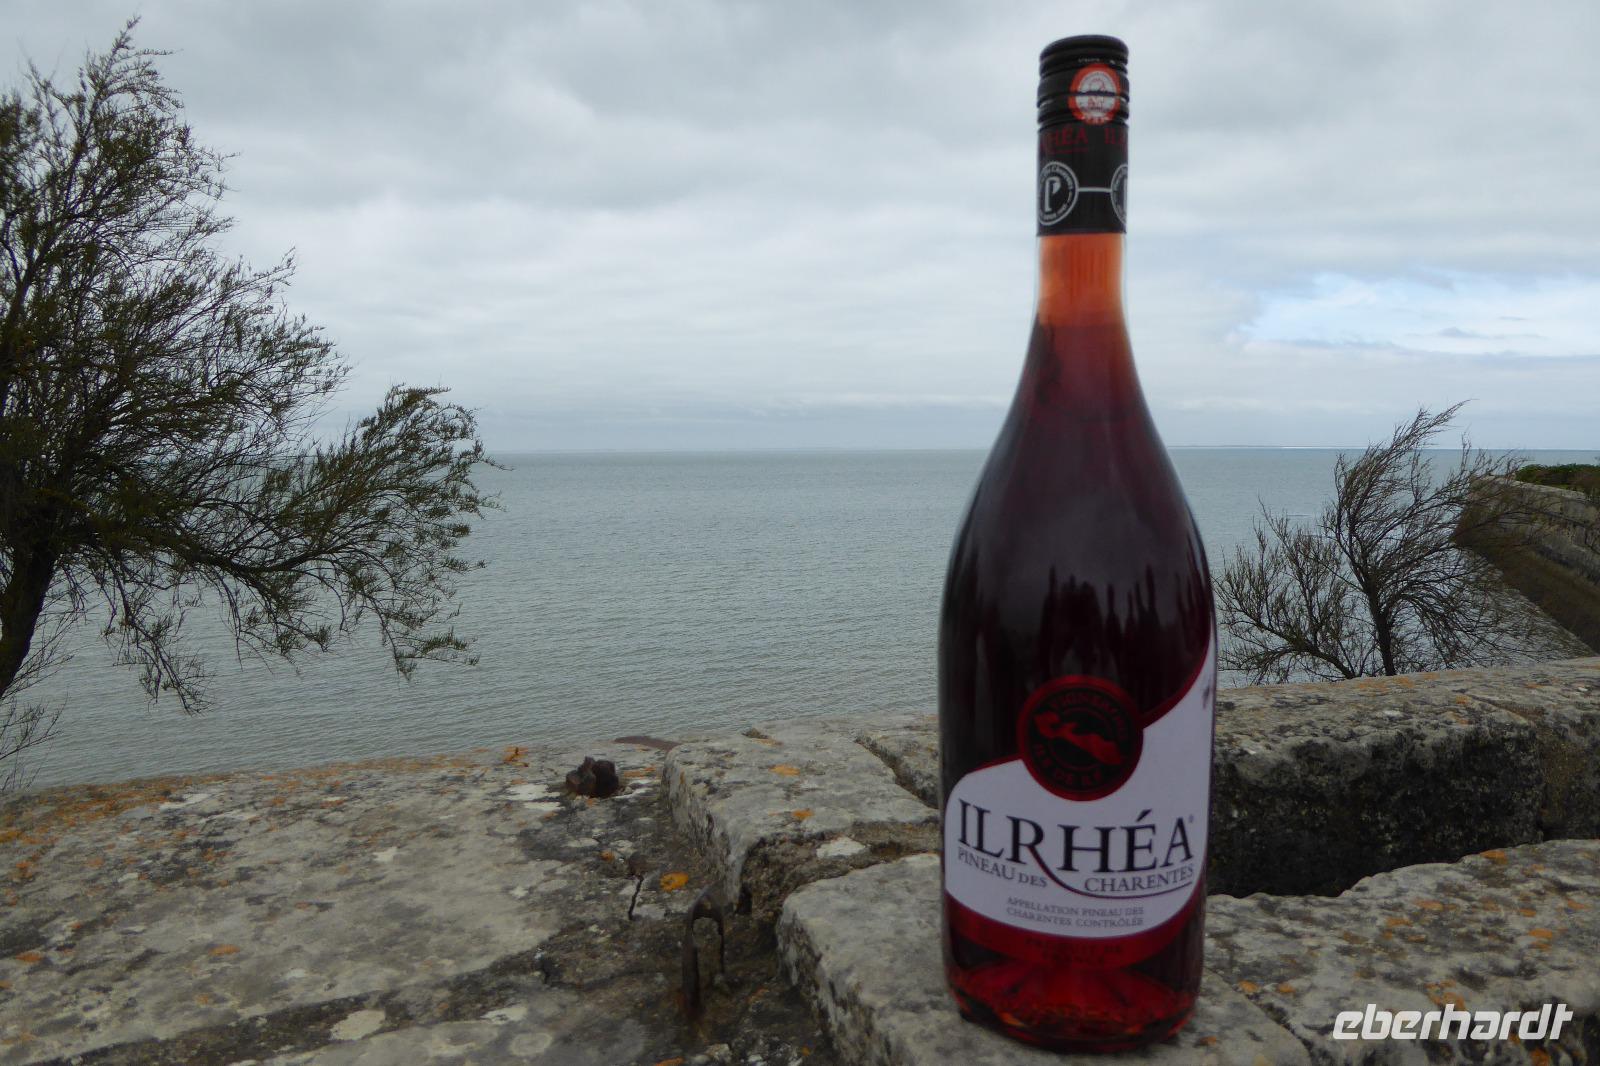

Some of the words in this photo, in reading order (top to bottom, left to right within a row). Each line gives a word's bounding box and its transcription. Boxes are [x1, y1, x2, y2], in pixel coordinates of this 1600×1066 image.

[957, 846, 1014, 880] PINEAU
[1017, 873, 1048, 889] DES
[1084, 864, 1195, 894] CHARENTES
[1006, 906, 1072, 927] CHARENTES
[1007, 896, 1079, 916] APPELLATION
[1081, 906, 1122, 917] PINEAU
[1125, 905, 1144, 916] DES
